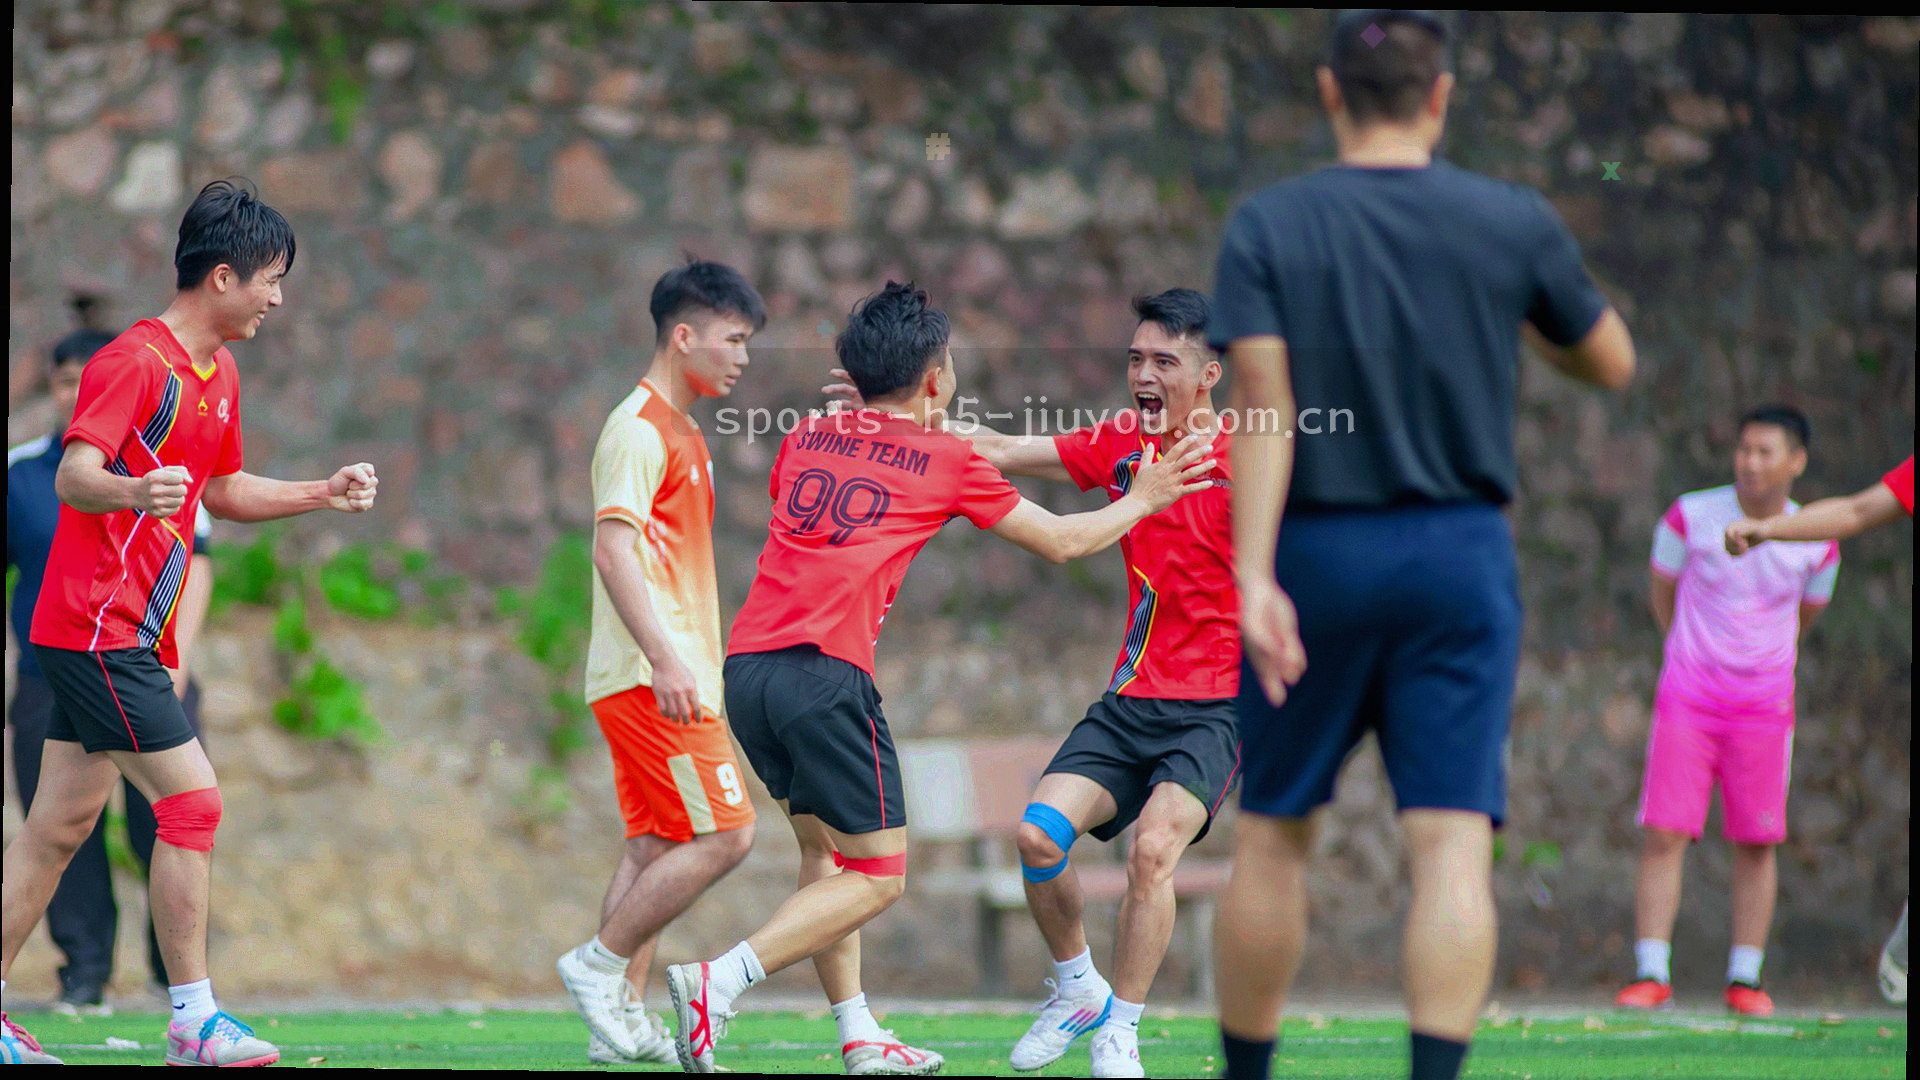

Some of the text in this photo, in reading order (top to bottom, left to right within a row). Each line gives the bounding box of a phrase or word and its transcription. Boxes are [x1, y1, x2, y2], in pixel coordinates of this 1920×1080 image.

[796, 430, 931, 476] SWINE TEAM
[785, 468, 890, 546] 99
[716, 763, 743, 806] 9
